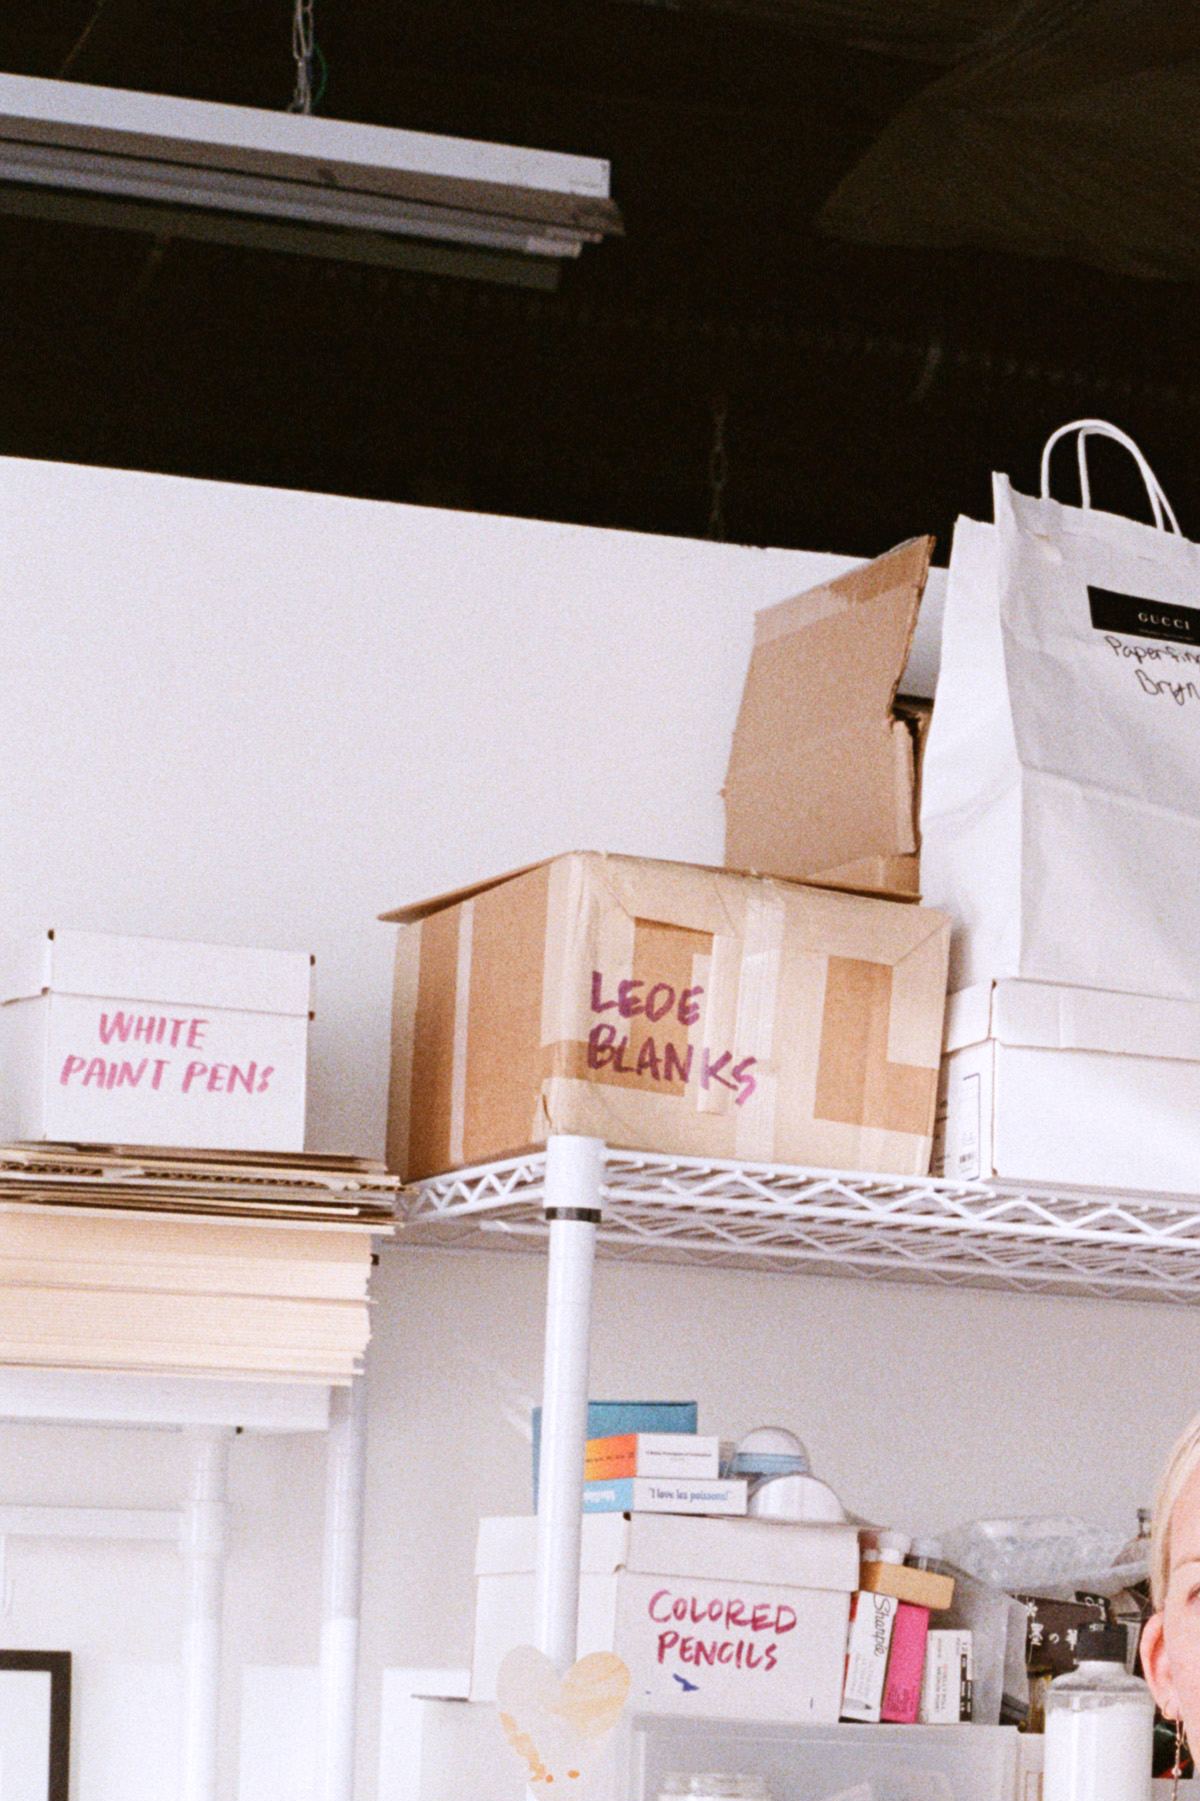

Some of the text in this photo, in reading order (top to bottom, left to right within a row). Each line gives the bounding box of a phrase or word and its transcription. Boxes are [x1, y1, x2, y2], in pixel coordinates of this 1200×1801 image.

[1138, 612, 1190, 631] GUCCI
[98, 1011, 209, 1050] WHITE
[60, 1054, 275, 1095] PAINT PENS
[588, 1023, 757, 1107] BLANKS
[648, 1589, 797, 1635] COLORED
[873, 1593, 892, 1657] Sharpie
[657, 1630, 777, 1672] PENCILS
